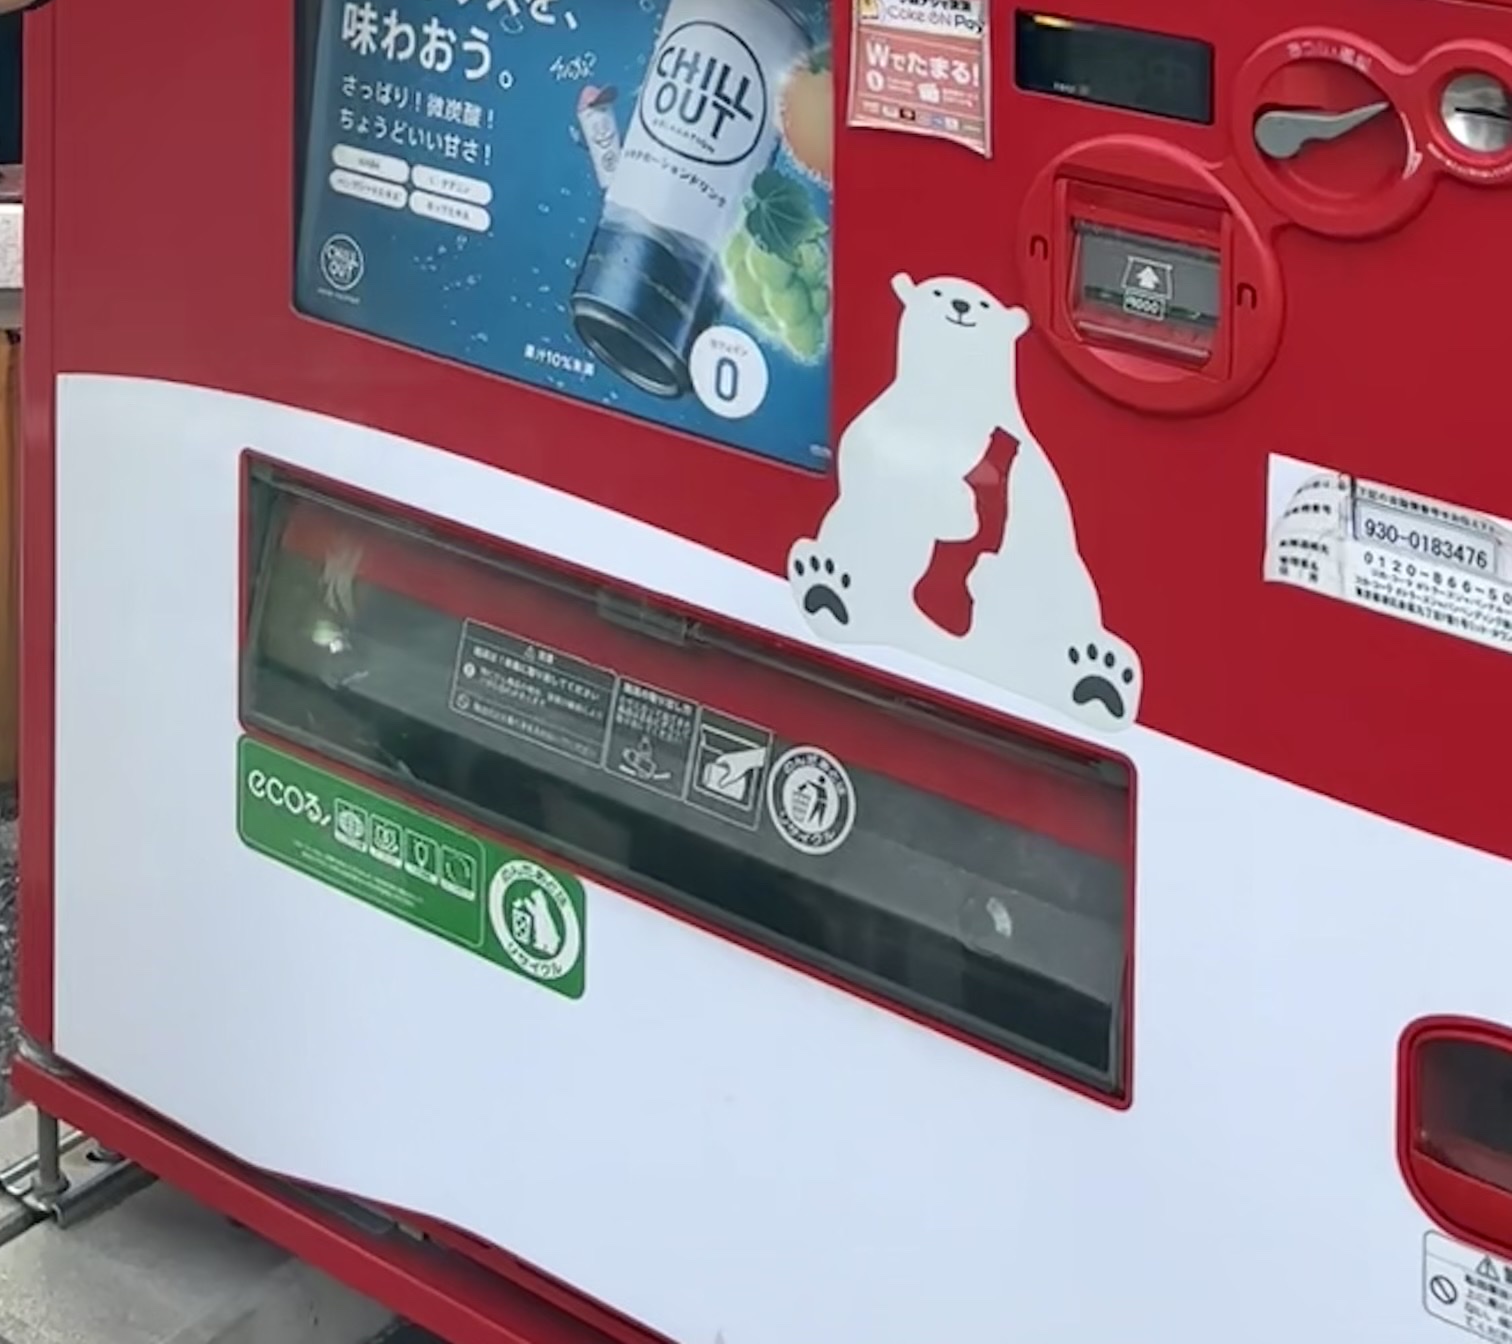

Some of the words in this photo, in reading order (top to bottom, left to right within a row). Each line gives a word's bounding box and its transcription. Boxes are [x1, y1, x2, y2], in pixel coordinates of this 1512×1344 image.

[887, 3, 927, 23] Coke
[928, 11, 952, 27] ON
[954, 14, 985, 34] Pay
[340, 0, 516, 91] 味わおう。
[865, 40, 980, 87] Wでたまる！
[340, 74, 495, 130] さっぱり！微炭酸！
[653, 81, 736, 140] OUT
[656, 46, 755, 123] CHILL
[339, 108, 493, 167] ちょうどいい甘さ！
[715, 357, 739, 403] 0
[1364, 518, 1488, 569] 930-0183476
[506, 939, 564, 978] リサイクル
